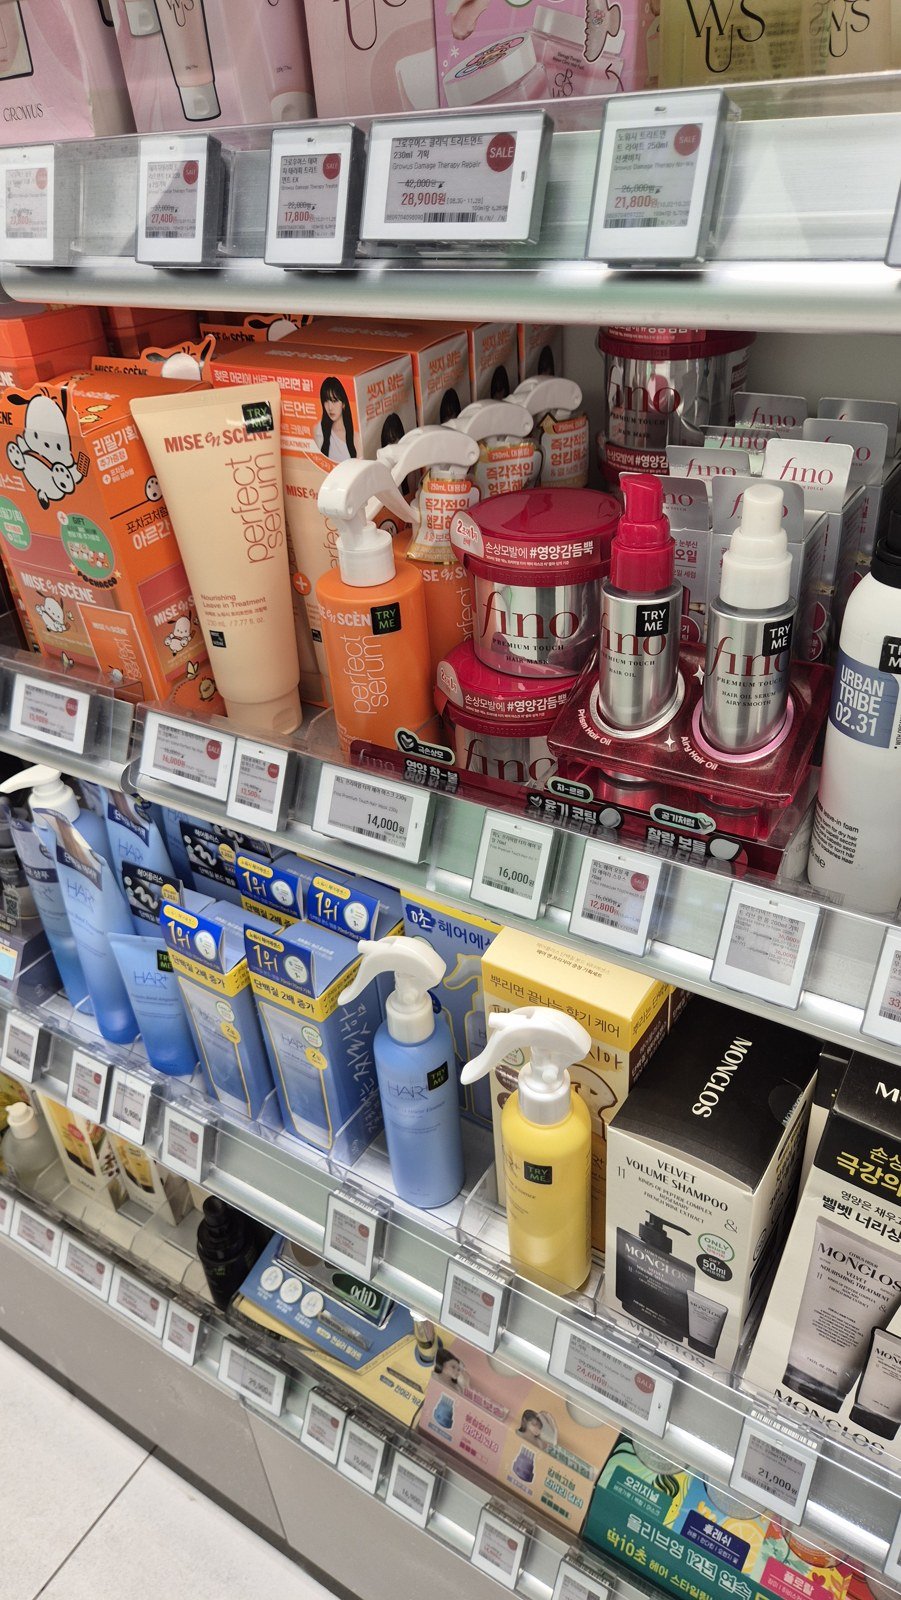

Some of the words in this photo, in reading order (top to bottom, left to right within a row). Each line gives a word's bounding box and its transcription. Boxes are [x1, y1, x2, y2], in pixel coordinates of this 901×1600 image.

[679, 135, 697, 145] SALE
[393, 151, 413, 159] 230ml
[416, 150, 430, 159] 기획
[489, 147, 514, 158] SALE
[414, 161, 436, 170] Damage
[438, 160, 460, 169] Therapy
[461, 160, 481, 168] Repair
[401, 192, 447, 207] 28,900원
[247, 408, 267, 418] TRY
[750, 406, 796, 429] fino
[93, 424, 139, 457] 리필기획
[164, 433, 204, 453] MISE
[486, 462, 533, 480] 즉각적인
[780, 457, 833, 486] fino
[254, 451, 283, 550] serum
[286, 485, 308, 498] MISE
[225, 453, 274, 564] perfect
[425, 498, 470, 513] 즉각적인
[485, 541, 528, 558] 손상모발에
[529, 540, 594, 560] #영양감듬뿍
[679, 540, 698, 549] 눈부신
[20, 572, 48, 591] MISE
[59, 581, 97, 604] SCÈNE
[200, 593, 237, 603] Nourishing
[203, 600, 222, 610] Leave
[230, 596, 266, 608] Treatment
[154, 610, 177, 627] MISE
[375, 608, 396, 620] TRY
[465, 591, 580, 640] fino
[642, 609, 667, 621] TRY
[379, 620, 396, 630] ME
[600, 612, 667, 657] fino
[644, 620, 663, 631] ME
[770, 624, 791, 638] TRY
[492, 638, 530, 651] PREMIUM
[533, 644, 565, 652] TOUCH
[771, 636, 788, 650] ME
[505, 654, 524, 663] HAIR
[526, 656, 549, 665] MASK
[628, 659, 656, 667] TOUCH
[340, 633, 378, 715] perfect
[362, 635, 389, 707] serum
[841, 664, 885, 697] URBAN
[716, 676, 756, 688] PREMIUM
[758, 677, 784, 687] TOUCH
[465, 694, 505, 712] 손상모발에
[722, 690, 737, 699] HAIR
[740, 692, 753, 700] OIL
[754, 690, 777, 699] SERUM
[725, 699, 741, 707] AIRY
[743, 699, 771, 708] SMOOTH
[839, 681, 882, 717] TRIBE
[577, 708, 590, 731] Prism
[585, 726, 601, 742] Hair
[599, 736, 612, 747] Oil
[835, 701, 877, 737] 02.31
[417, 744, 445, 759] 극손상모
[680, 735, 691, 752] Airy
[689, 749, 705, 766] Hair
[705, 759, 718, 771] Oil
[405, 759, 428, 775] 영양
[544, 798, 569, 818] 윤기
[572, 806, 597, 825] 코팅
[662, 811, 695, 828] 공기처럼
[367, 813, 405, 835] 14,000원
[842, 822, 859, 834] foam
[647, 827, 675, 847] 찰랑
[137, 868, 164, 883] 헤어플러스
[242, 871, 267, 897] 1위
[499, 866, 535, 887] 16,000원
[245, 902, 268, 916] 단백질
[315, 892, 340, 922] 1위
[590, 899, 620, 916] 12,800원
[167, 920, 191, 950] 1위
[253, 945, 279, 973] 1위
[172, 954, 194, 973] 단백질
[209, 974, 226, 989] 증가
[253, 980, 279, 998] 단백질
[280, 991, 296, 1006] 2배
[297, 999, 316, 1014] 증가
[490, 974, 526, 998] 뿌리면
[594, 1015, 621, 1038] 케어
[691, 1036, 754, 1119] MONCLOS
[526, 1166, 549, 1176] TRY
[527, 1174, 546, 1183] ME
[657, 1159, 696, 1185] VELVET
[626, 1156, 669, 1185] VOLUME
[672, 1179, 729, 1213] SHAMPOO
[638, 1176, 655, 1188] KINDS
[662, 1189, 684, 1203] PEPTIDE
[686, 1199, 713, 1217] COMPLEX
[659, 1193, 690, 1211] ROSEMARY
[841, 1190, 872, 1211] 영양은
[644, 1191, 665, 1206] FRENCH
[665, 1202, 678, 1212] WINE
[679, 1209, 705, 1224] EXTRACT
[822, 1195, 853, 1220] 벨벳
[724, 1218, 738, 1234] &
[704, 1236, 729, 1251] ONLY
[625, 1242, 688, 1283] MONCLOS
[702, 1258, 727, 1276] 50ml
[818, 1242, 901, 1292] MONCLOS
[848, 1250, 862, 1264] CITRUS
[862, 1258, 878, 1269] HOUR
[820, 1264, 855, 1287] NOURISHING
[855, 1282, 890, 1303] TREATMENT
[846, 1270, 867, 1285] VELVET
[774, 1387, 886, 1457] MONCLOS
[623, 1475, 661, 1504] 오리지널
[757, 1466, 798, 1496] 21,000원
[606, 1526, 648, 1566] 딱10초
[626, 1513, 685, 1560] 올리브영
[685, 1549, 718, 1582] 12년
[718, 1569, 752, 1600] 연속
[649, 1558, 669, 1580] 헤어
